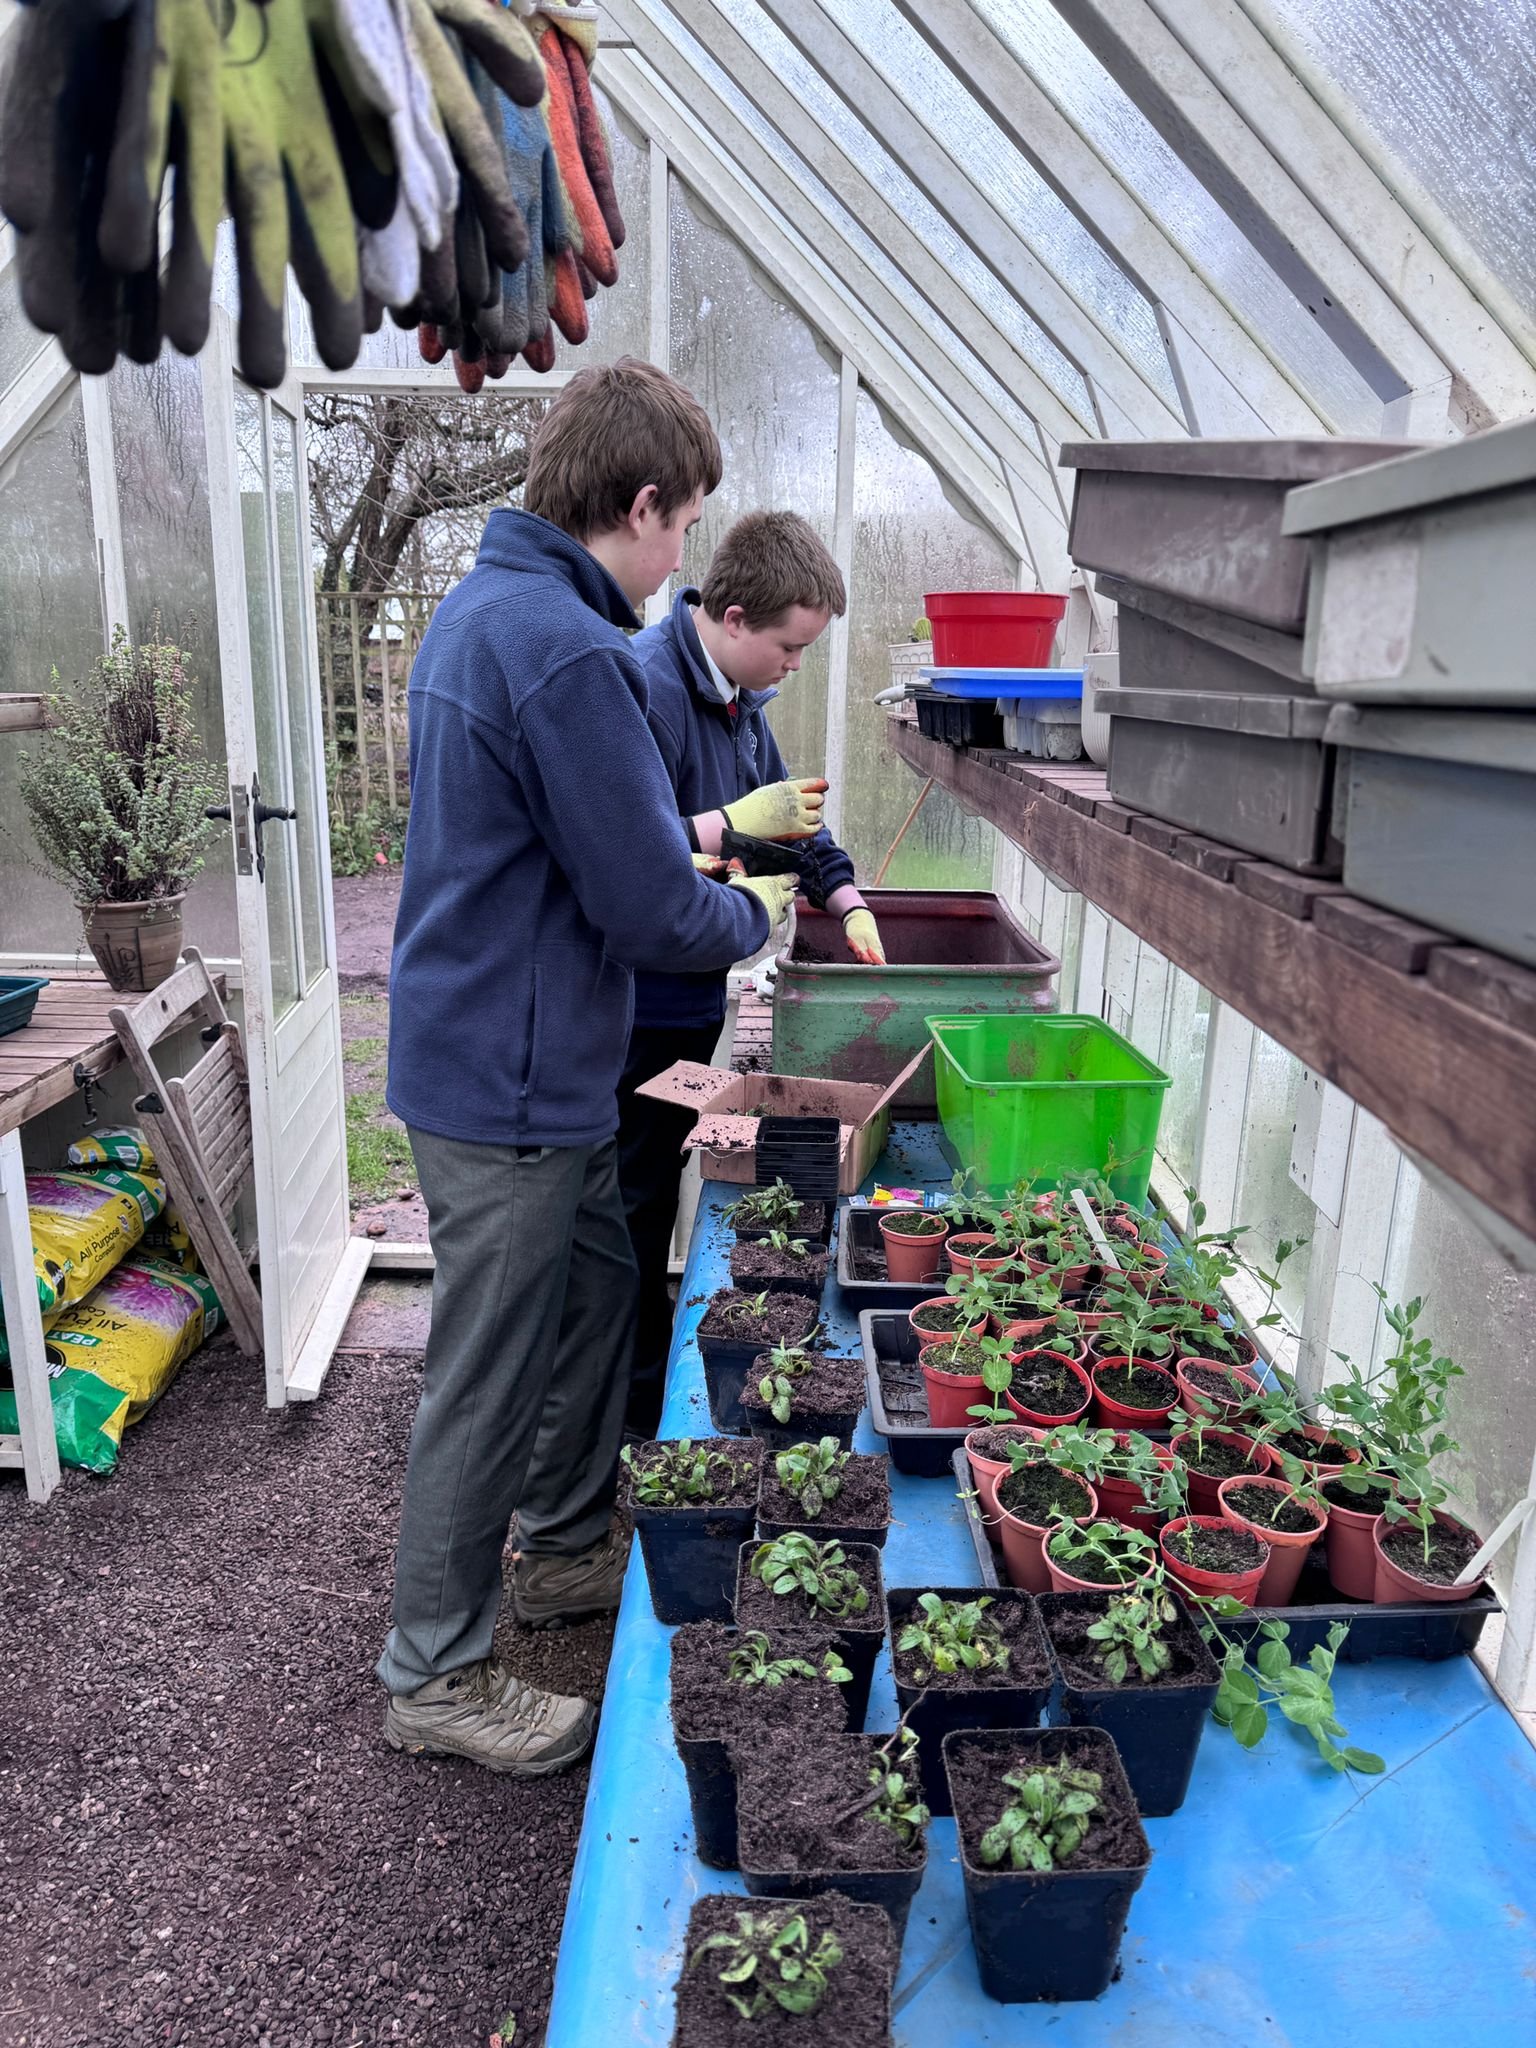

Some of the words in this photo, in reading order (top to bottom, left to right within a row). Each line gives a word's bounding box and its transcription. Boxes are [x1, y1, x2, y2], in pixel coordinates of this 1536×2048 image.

[80, 1246, 93, 1263] All
[91, 1226, 120, 1253] Purpose
[94, 1242, 116, 1263] Compost
[96, 1319, 128, 1331] All
[47, 1332, 97, 1346] PEAT
